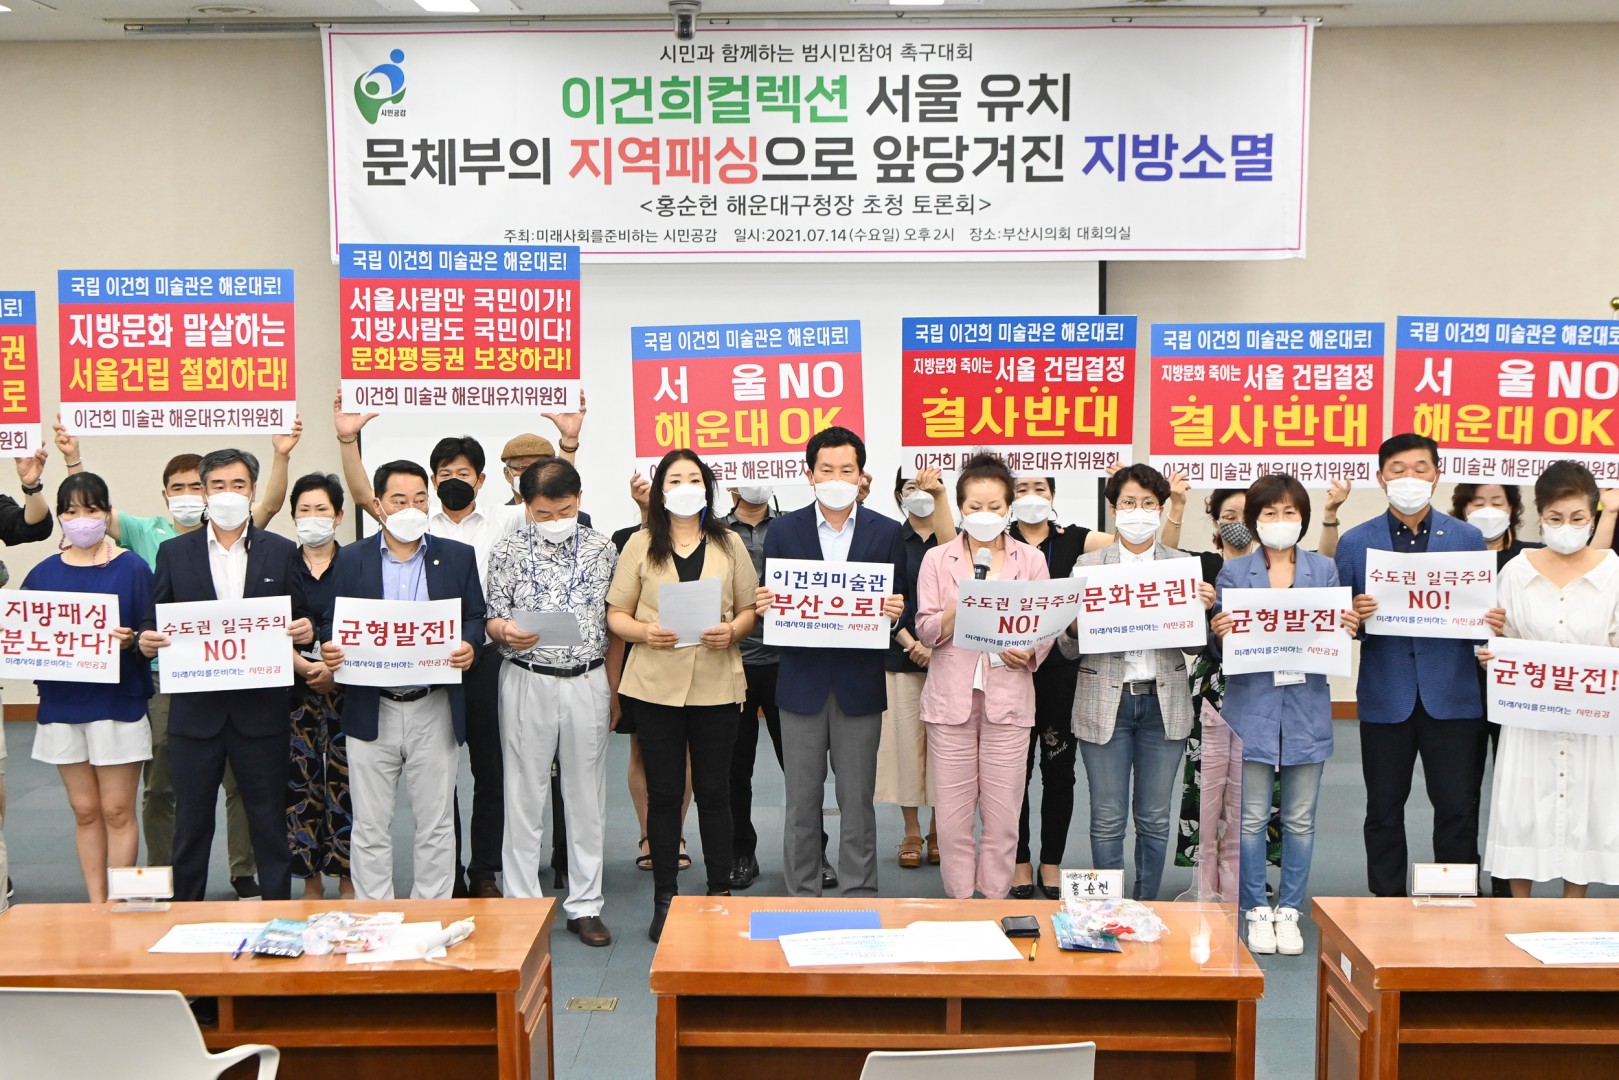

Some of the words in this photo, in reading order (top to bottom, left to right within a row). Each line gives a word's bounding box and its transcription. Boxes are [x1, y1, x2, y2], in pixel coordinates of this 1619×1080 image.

[660, 44, 714, 63] 시민과
[722, 44, 794, 62] 함께하는
[803, 44, 891, 62] 범시민참여
[900, 43, 972, 62] 촉구대회
[563, 75, 847, 124] 이건희컬렉션
[866, 74, 961, 122] 서울
[977, 73, 1070, 122] 유치
[381, 109, 406, 117] 시민공감
[363, 138, 550, 186] 문체부의
[569, 136, 857, 185] 지역패싱으로
[873, 135, 1063, 183] 앞당겨진
[1082, 133, 1273, 181] 지방소멸
[640, 195, 717, 217] <홍순헌
[727, 195, 854, 216] 해운대구청장
[862, 195, 902, 216] 초청
[912, 194, 991, 215] 토론회>
[664, 229, 717, 243] 시민공감
[970, 227, 1070, 241] 장소:부산시의회
[1078, 226, 1130, 240] 대회의실
[353, 250, 381, 270] 국립
[389, 251, 432, 270] 이건희
[439, 251, 497, 271] 미술관은
[504, 251, 566, 271] 해운대로!
[72, 277, 99, 296] 국립
[106, 277, 149, 296] 이건희
[156, 277, 213, 296] 미술관은
[219, 277, 281, 296] 해운대로!
[350, 288, 465, 312] 서울사람만
[474, 288, 570, 312] 국민이가!
[70, 314, 173, 348] 지방문화
[184, 313, 285, 347] 말살하는
[351, 317, 464, 342] 지방사람도
[474, 318, 571, 342] 국민이다!
[645, 332, 671, 351] 국립
[678, 331, 719, 350] 이건희
[726, 329, 782, 348] 미술관은
[788, 327, 848, 347] 해운대로!
[916, 324, 943, 343] 국립
[950, 324, 991, 343] 이건희
[999, 323, 1055, 342] 미술관은
[1062, 323, 1124, 342] 해운대로!
[1164, 331, 1191, 350] 국립
[1198, 330, 1240, 350] 이건희
[1247, 330, 1304, 349] 미술관은
[1310, 330, 1371, 349] 해운대로!
[1410, 322, 1439, 342] 국립
[1445, 323, 1489, 343] 이건희
[1496, 324, 1556, 344] 미술관은
[352, 347, 464, 371] 문화평등권
[475, 347, 571, 371] 보장하라!
[914, 358, 957, 374] 지방문화
[961, 357, 992, 373] 죽이는
[996, 357, 1035, 382] 서울
[1044, 356, 1124, 382] 건립결정
[69, 358, 169, 392] 서울건립
[180, 357, 287, 391] 철회하라!
[779, 361, 843, 398] NO
[1162, 365, 1205, 382] 지방문화
[1209, 365, 1241, 381] 죽이는
[1244, 364, 1284, 390] 서울
[1293, 364, 1373, 390] 건립결정
[1548, 360, 1619, 400] NO
[356, 387, 398, 406] 이건희
[405, 387, 447, 406] 미술관
[452, 387, 566, 406] 해운대유치위원회
[75, 410, 116, 428] 이건희
[123, 409, 164, 428] 미술관
[170, 408, 282, 427] 해운대유치위원회
[921, 395, 1118, 438] 결사반대
[1170, 404, 1367, 447] 결사반대
[1414, 403, 1534, 445] 해운대
[1545, 407, 1614, 445] OK
[655, 409, 769, 449] 해운대
[1008, 451, 1120, 471] 해운대유치위원회
[1163, 462, 1204, 481] 이건희
[1211, 462, 1252, 481] 미술관
[1454, 457, 1496, 476] 미술관
[774, 571, 887, 592] 이건희미술관
[1370, 569, 1416, 585] 수도권
[1427, 570, 1491, 586] 일극주의
[770, 594, 885, 619] 부산으로!
[962, 596, 1009, 611] 수도권
[1020, 593, 1079, 612] 일극주의
[1082, 578, 1196, 612] 문화분권!
[1409, 591, 1450, 609] NO!
[5, 601, 107, 630] 지방패싱
[162, 620, 210, 637] 수도권
[222, 615, 286, 634] 일극주의
[998, 615, 1039, 633] NO!
[0, 629, 114, 657] 분노한다!
[338, 619, 455, 647] 균형발전!
[204, 639, 246, 661] NO!
[1494, 659, 1618, 695] 균형발전!
